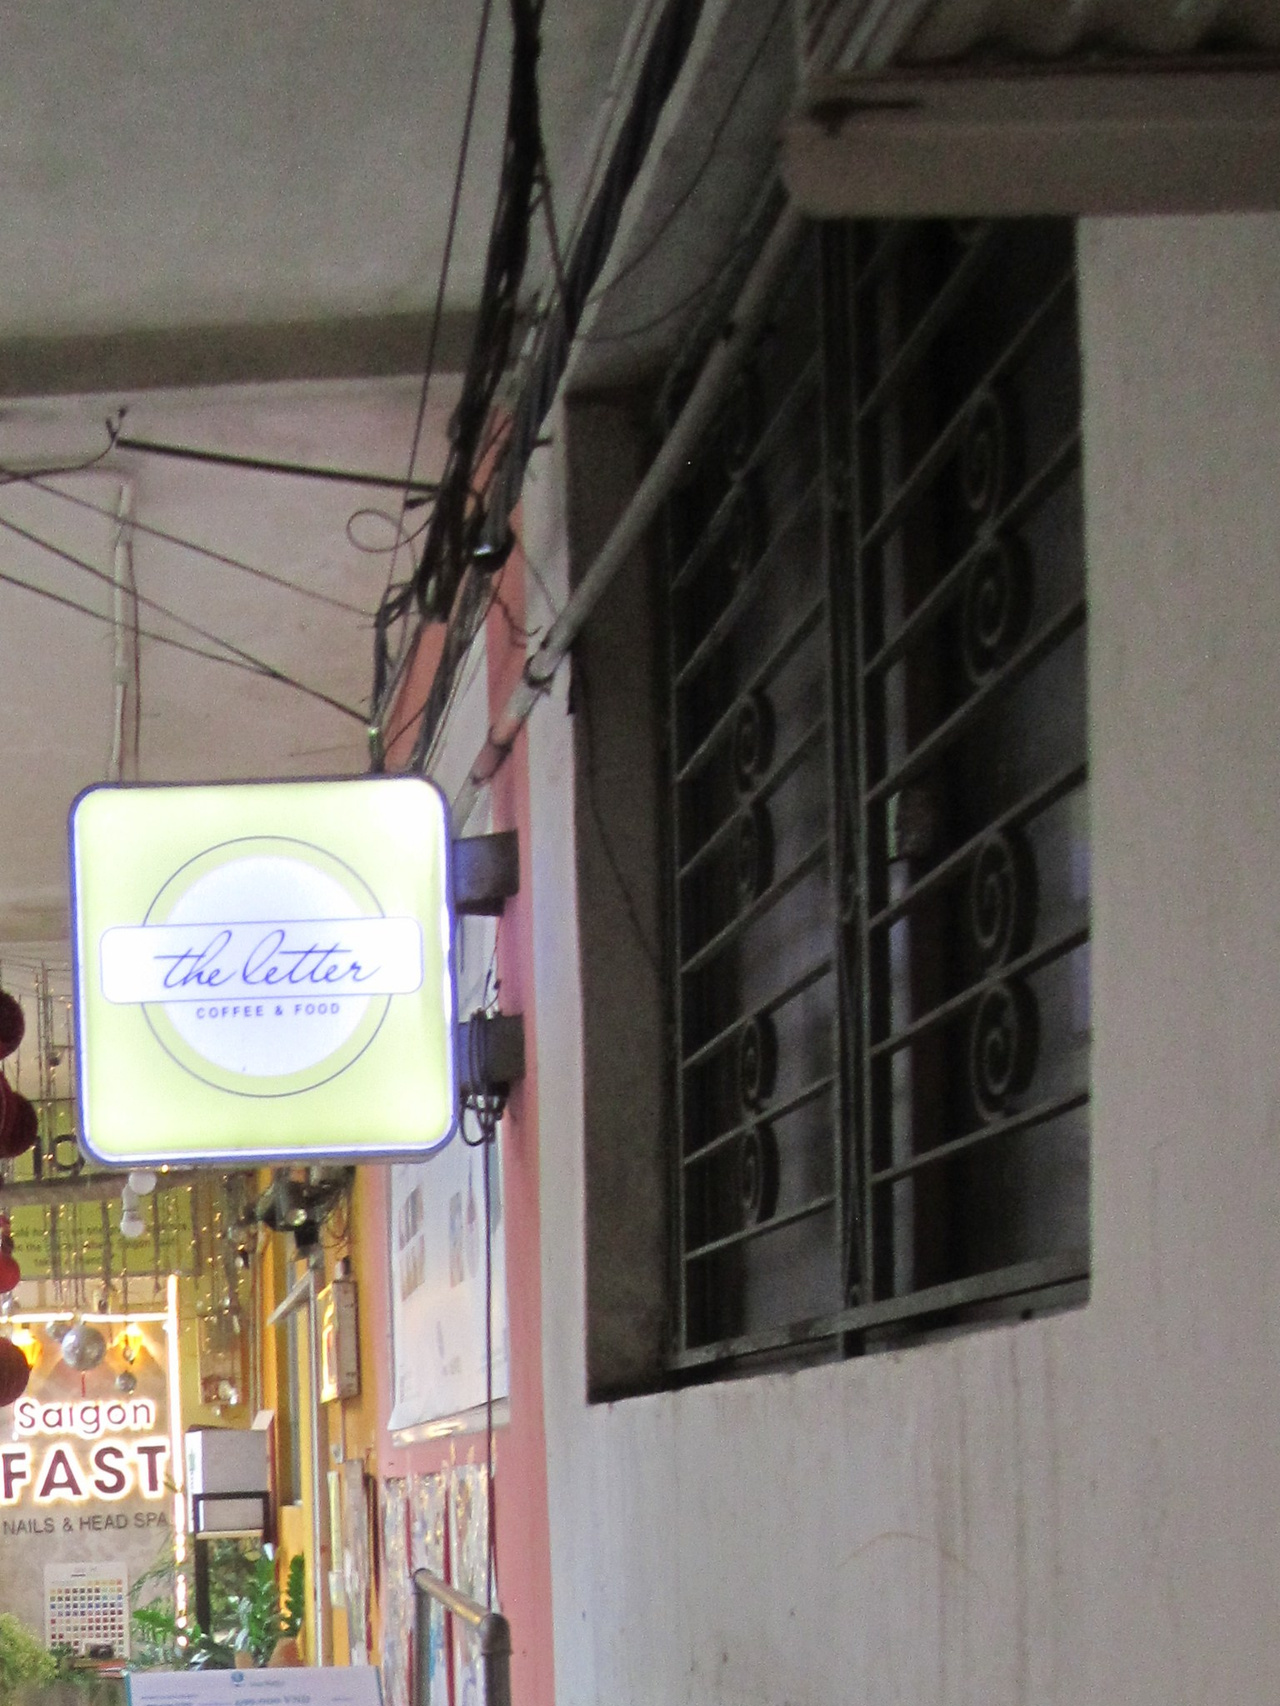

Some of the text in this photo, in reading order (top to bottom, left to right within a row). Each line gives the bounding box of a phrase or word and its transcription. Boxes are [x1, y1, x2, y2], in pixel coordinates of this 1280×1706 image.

[153, 929, 382, 989] the letter
[195, 1002, 341, 1020] COFFEE & FOOD
[18, 1401, 152, 1435] Saigon
[1, 1444, 167, 1500] FAST
[3, 1511, 169, 1535] NAILS & HEAD SPA
